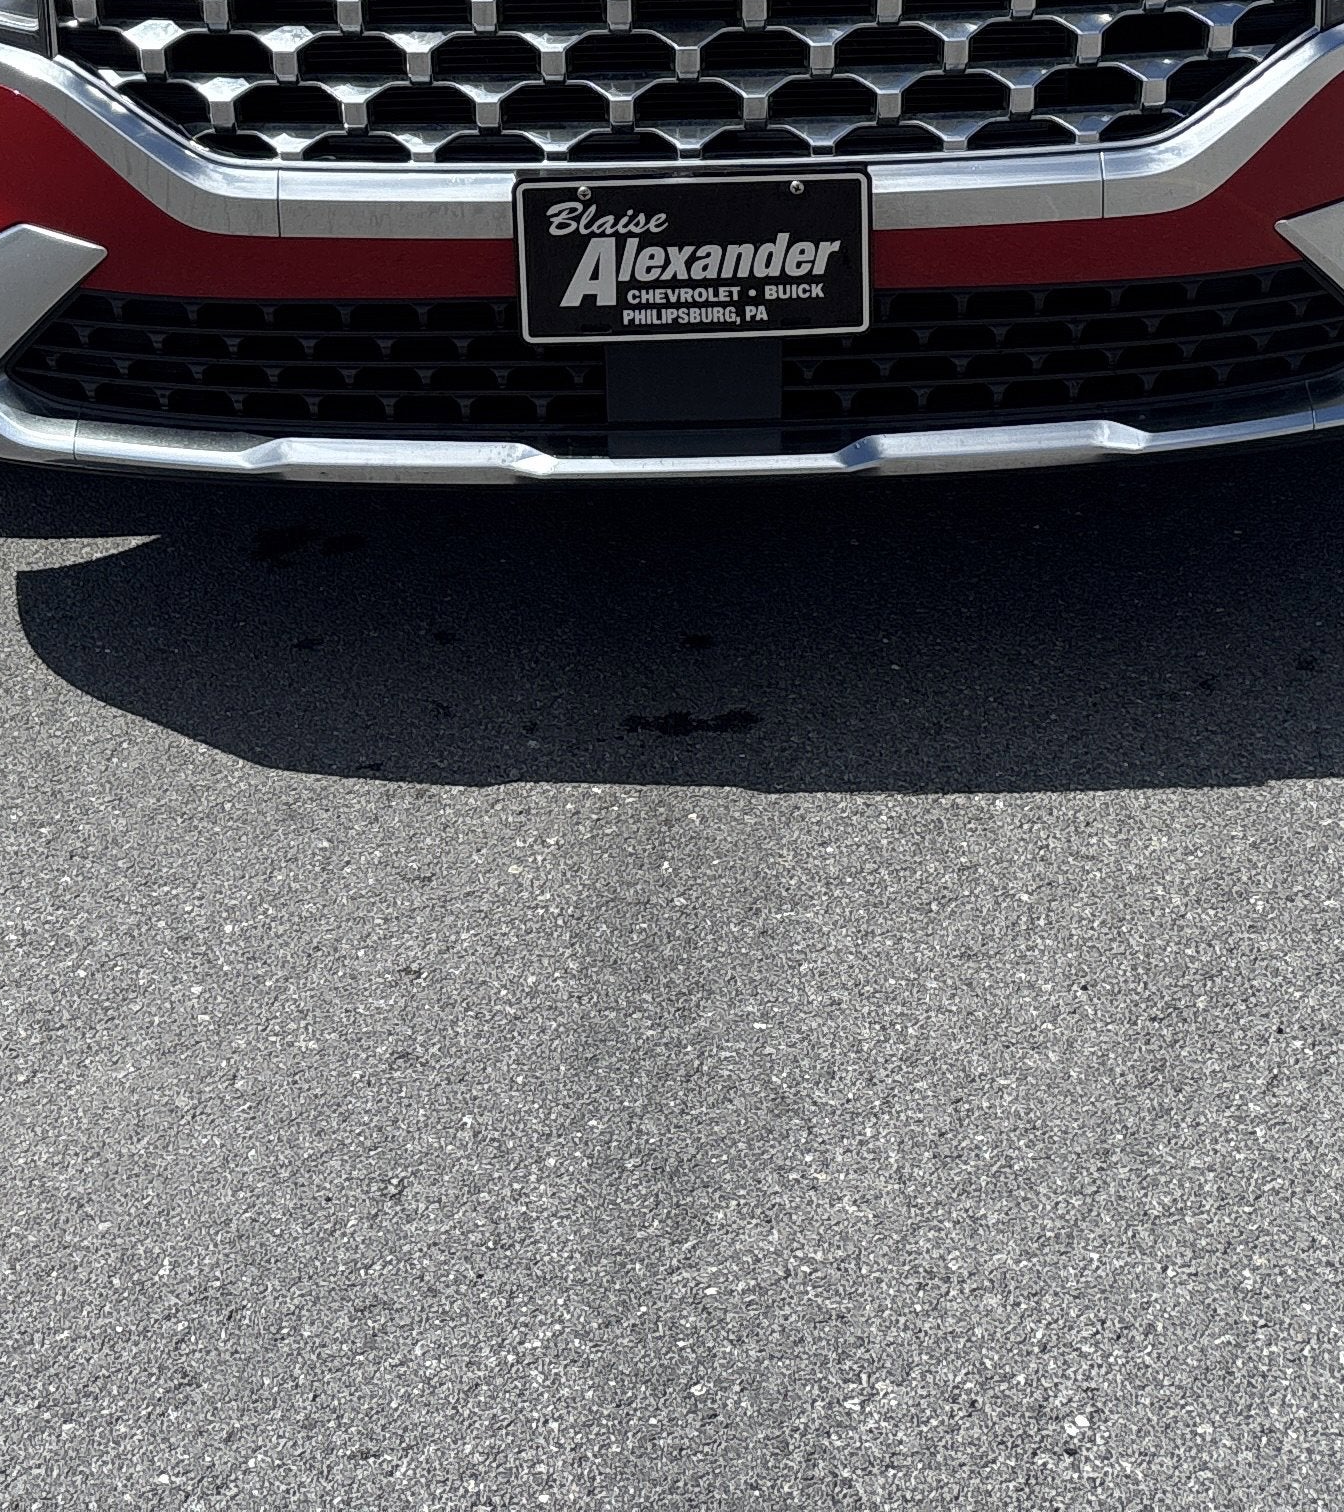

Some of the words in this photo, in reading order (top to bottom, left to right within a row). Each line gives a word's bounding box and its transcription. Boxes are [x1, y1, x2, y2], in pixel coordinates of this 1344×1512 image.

[546, 201, 669, 237] Blaise
[559, 232, 842, 308] Alexander
[626, 286, 741, 305] CHEVROLET
[764, 283, 825, 301] BUICK
[622, 306, 741, 326] PHILIPSBURG,
[744, 305, 768, 322] PA
